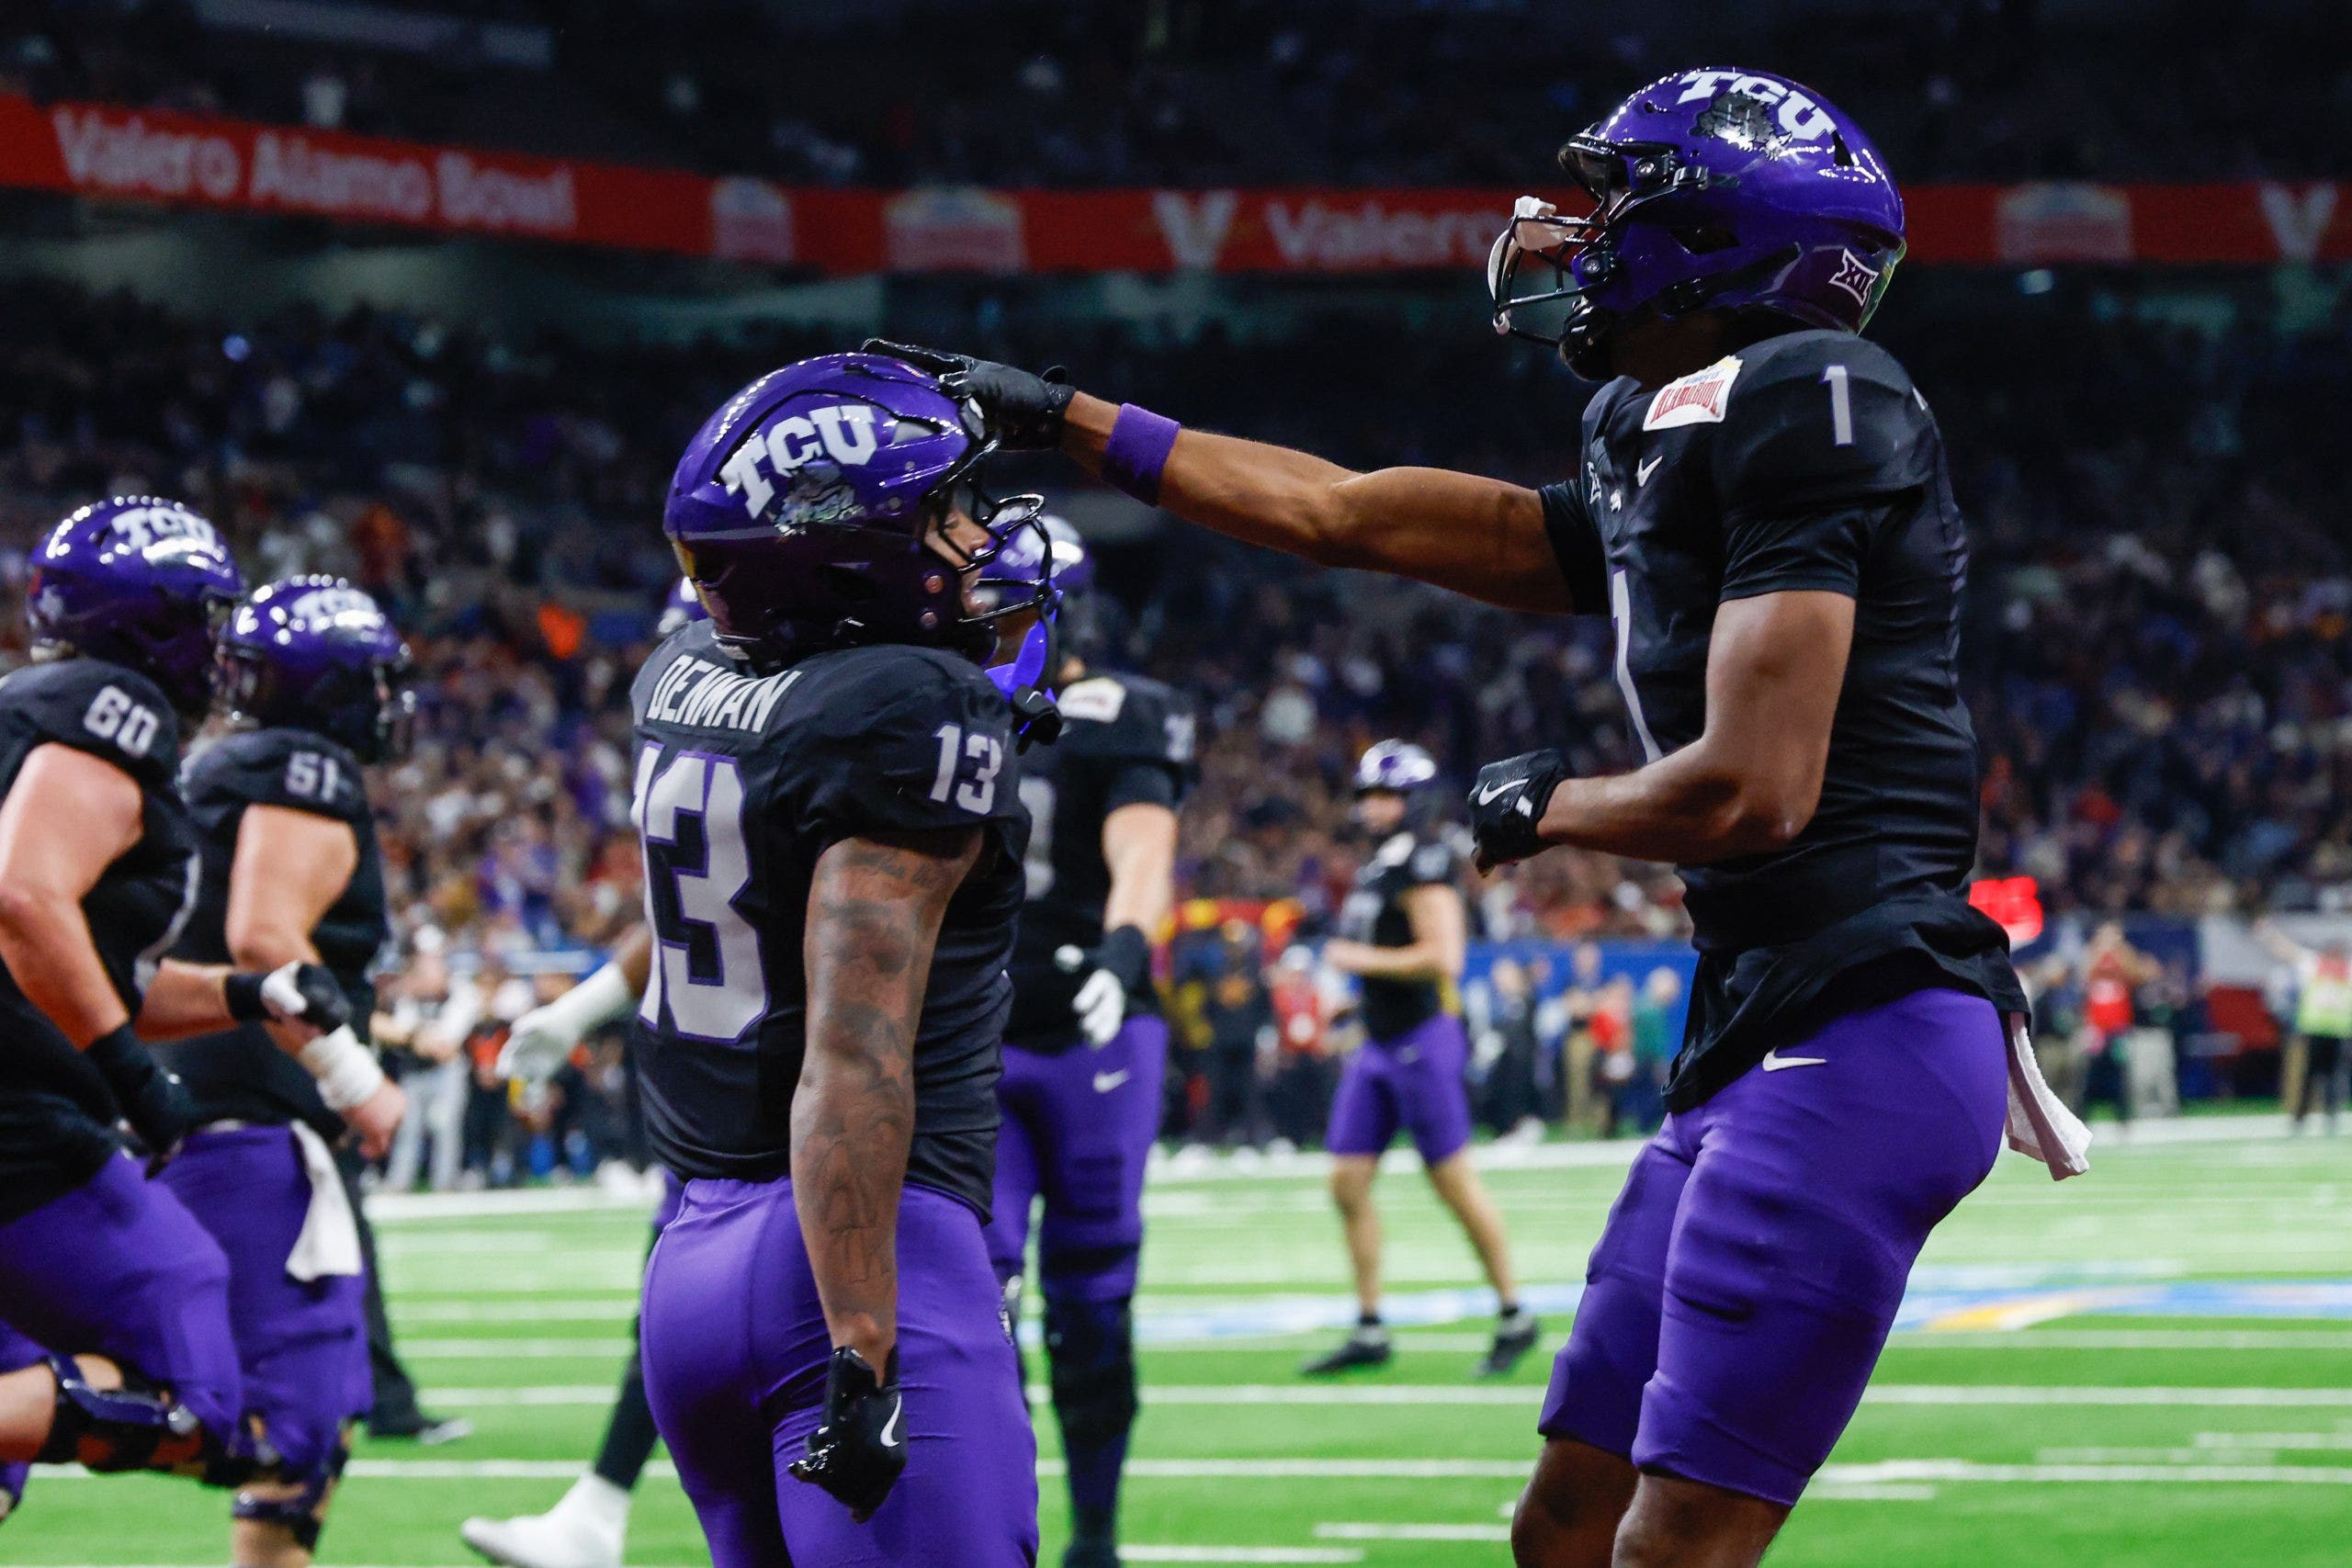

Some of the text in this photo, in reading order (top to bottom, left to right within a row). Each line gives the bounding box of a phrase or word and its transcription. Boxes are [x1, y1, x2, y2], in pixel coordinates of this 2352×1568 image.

[1676, 70, 1838, 141] TCU
[52, 105, 579, 230] Valero Alamo Bowl
[1267, 199, 1511, 263] Valero
[1822, 365, 1854, 446] 1
[719, 404, 877, 520] TCU
[110, 506, 217, 552] TCU
[84, 685, 159, 758] 60
[646, 655, 802, 733] DENMAN
[285, 750, 350, 801] 51
[928, 723, 1003, 816] 13
[632, 740, 770, 1044] 13
